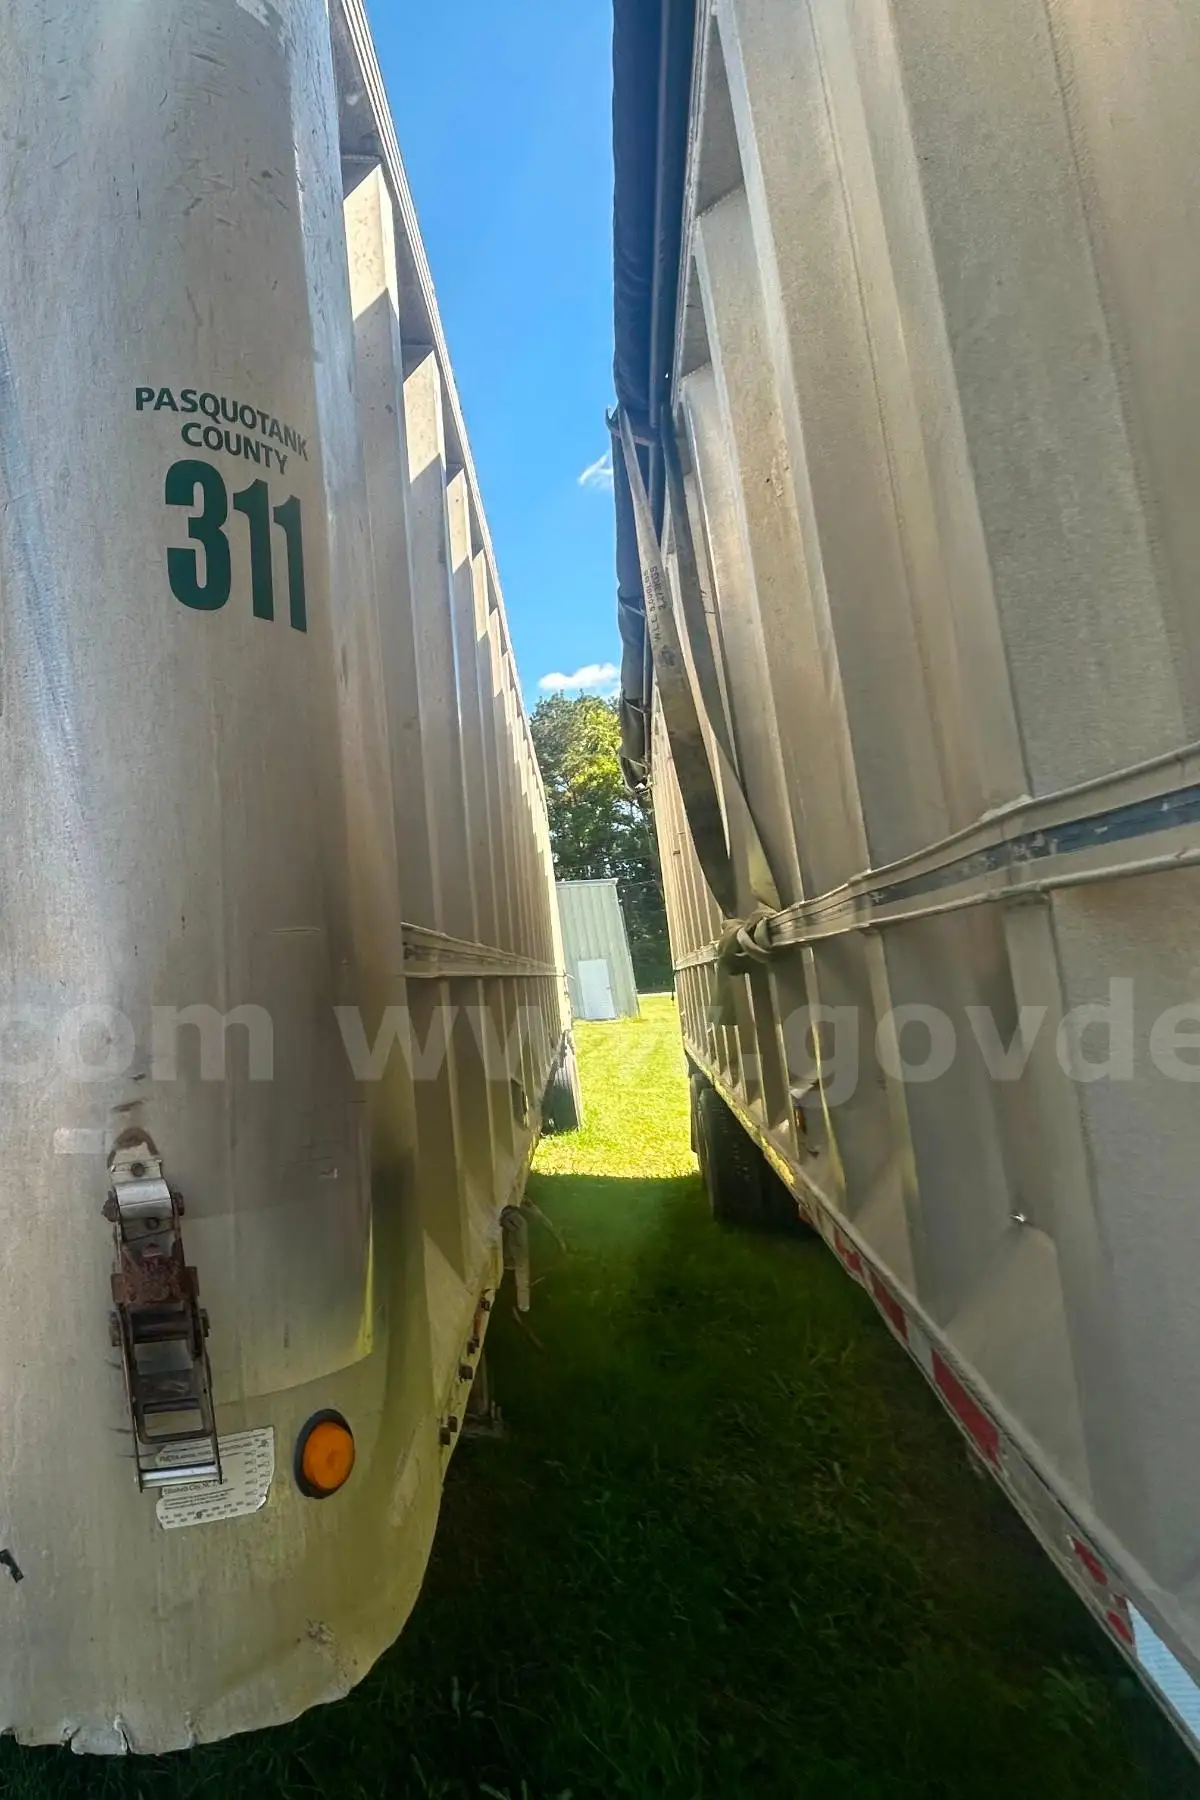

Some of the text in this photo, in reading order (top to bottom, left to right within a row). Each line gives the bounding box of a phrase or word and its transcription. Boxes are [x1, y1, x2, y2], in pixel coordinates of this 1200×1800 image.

[135, 387, 308, 461] PASQUOTANK
[181, 422, 288, 475] COUNTY
[165, 459, 307, 633] 311
